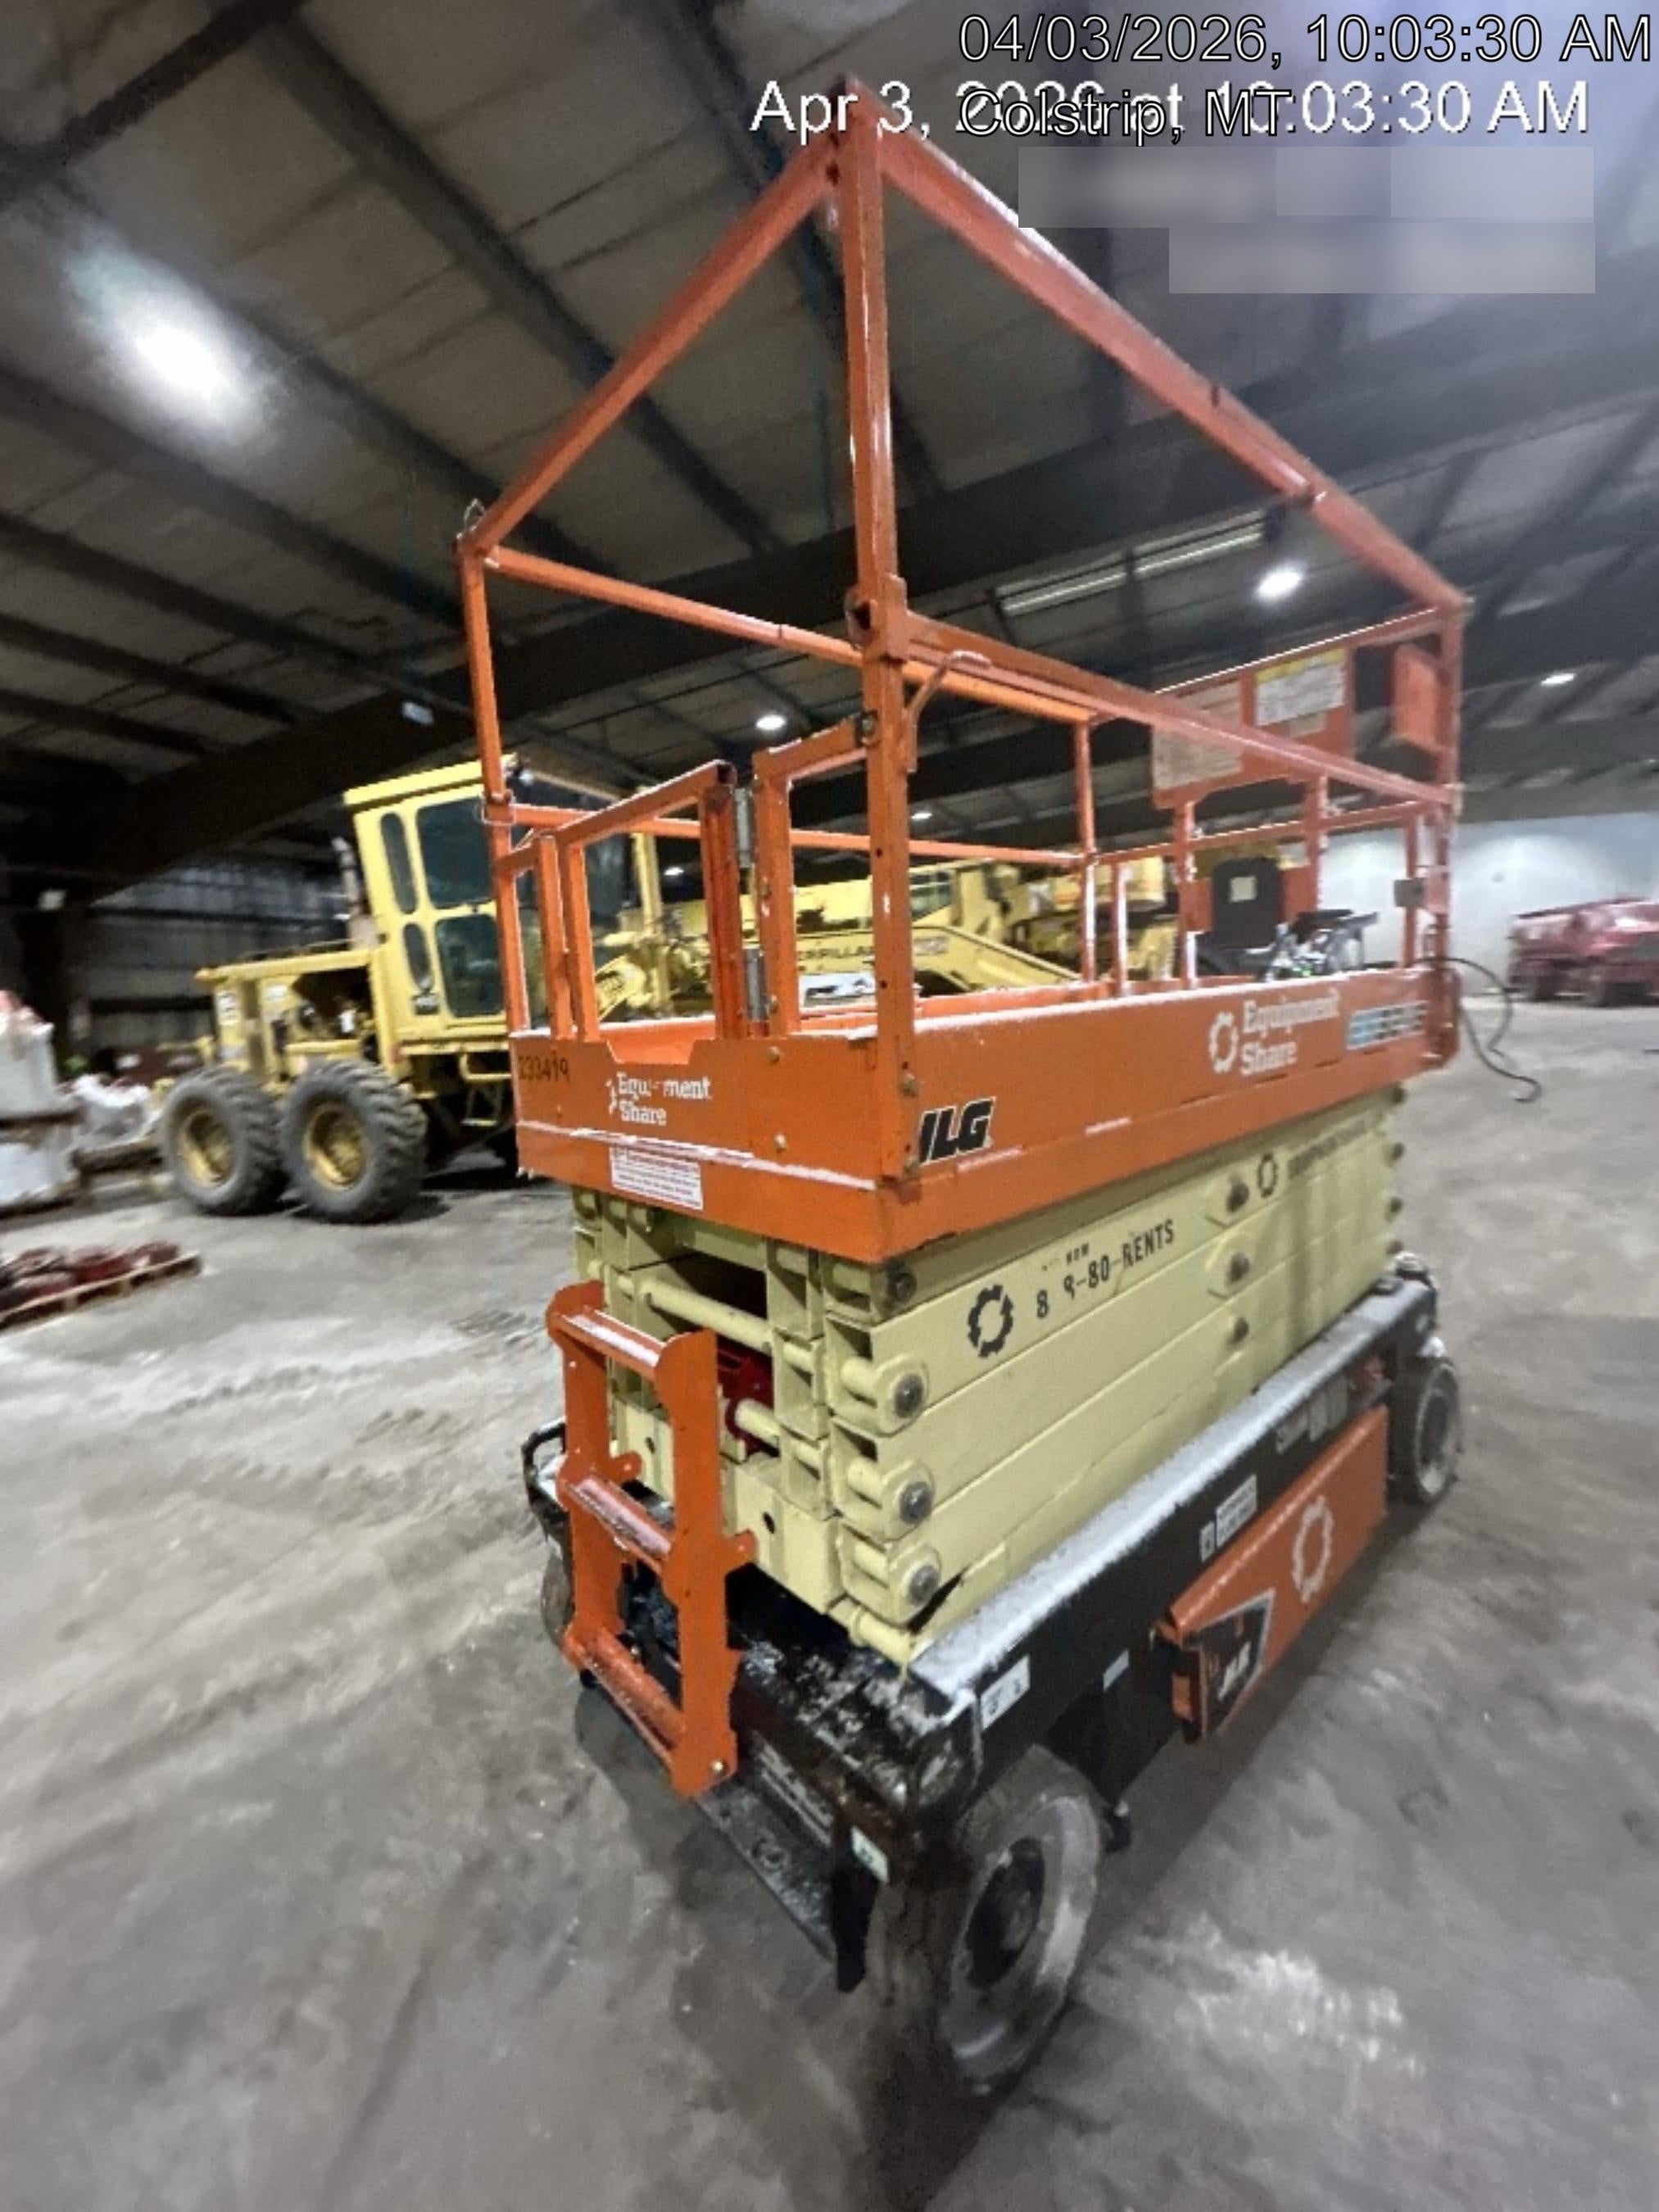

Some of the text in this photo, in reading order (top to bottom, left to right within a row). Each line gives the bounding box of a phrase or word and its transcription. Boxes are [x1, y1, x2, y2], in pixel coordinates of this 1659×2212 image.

[1240, 1041, 1299, 1076] Share
[616, 1071, 712, 1101] Equment
[619, 1099, 667, 1126] Share
